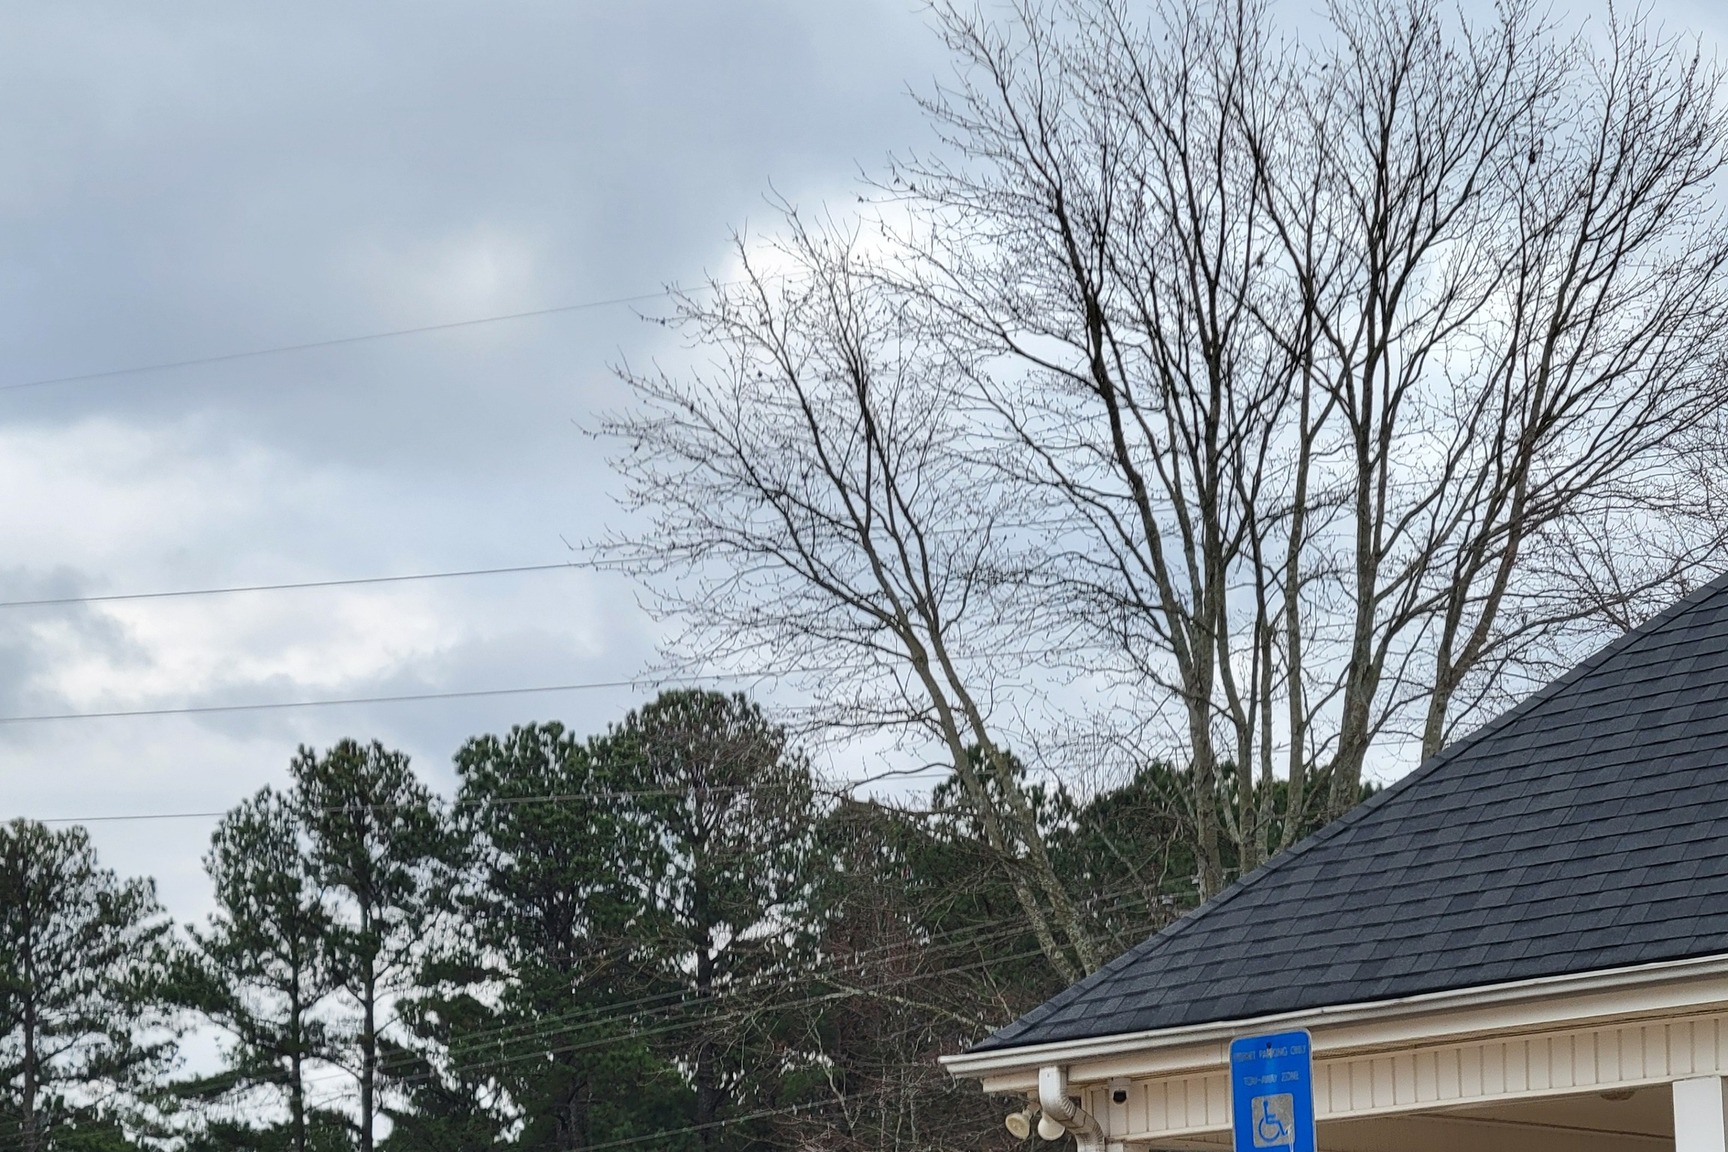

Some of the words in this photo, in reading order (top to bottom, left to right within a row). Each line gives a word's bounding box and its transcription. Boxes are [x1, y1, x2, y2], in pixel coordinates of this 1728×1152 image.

[1259, 1047, 1287, 1059] PARKING
[1290, 1045, 1306, 1055] ONLY
[1244, 1074, 1277, 1086] TOW-AWAY
[1282, 1071, 1299, 1082] ZONE
